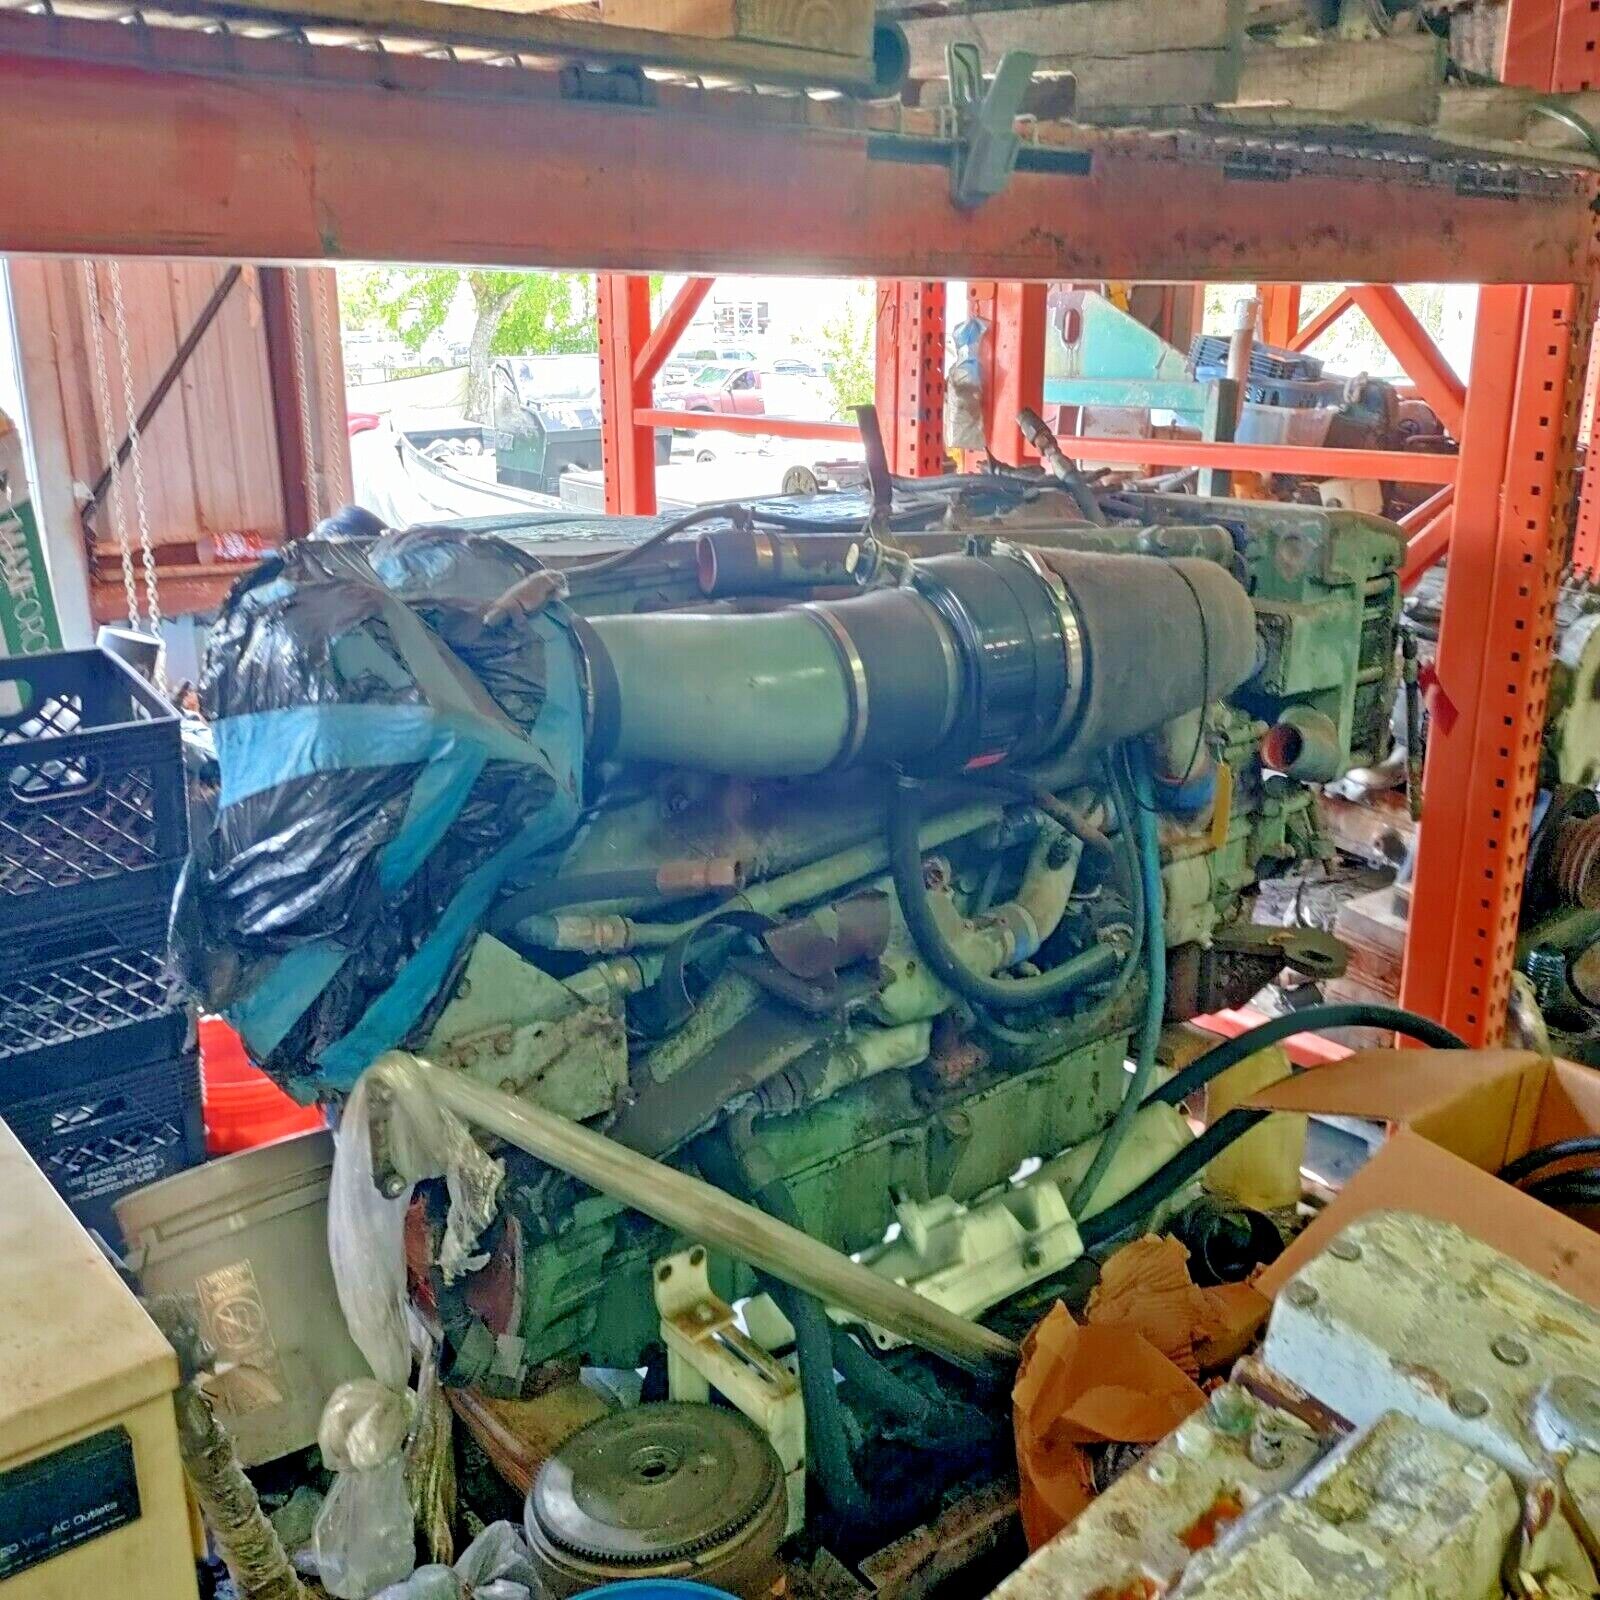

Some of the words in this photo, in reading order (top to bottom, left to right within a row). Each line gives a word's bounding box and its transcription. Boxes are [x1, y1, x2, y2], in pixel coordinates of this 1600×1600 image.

[0, 519, 51, 656] MAXIFORC
[51, 1520, 71, 1537] AC
[73, 1501, 118, 1526] Outlets
